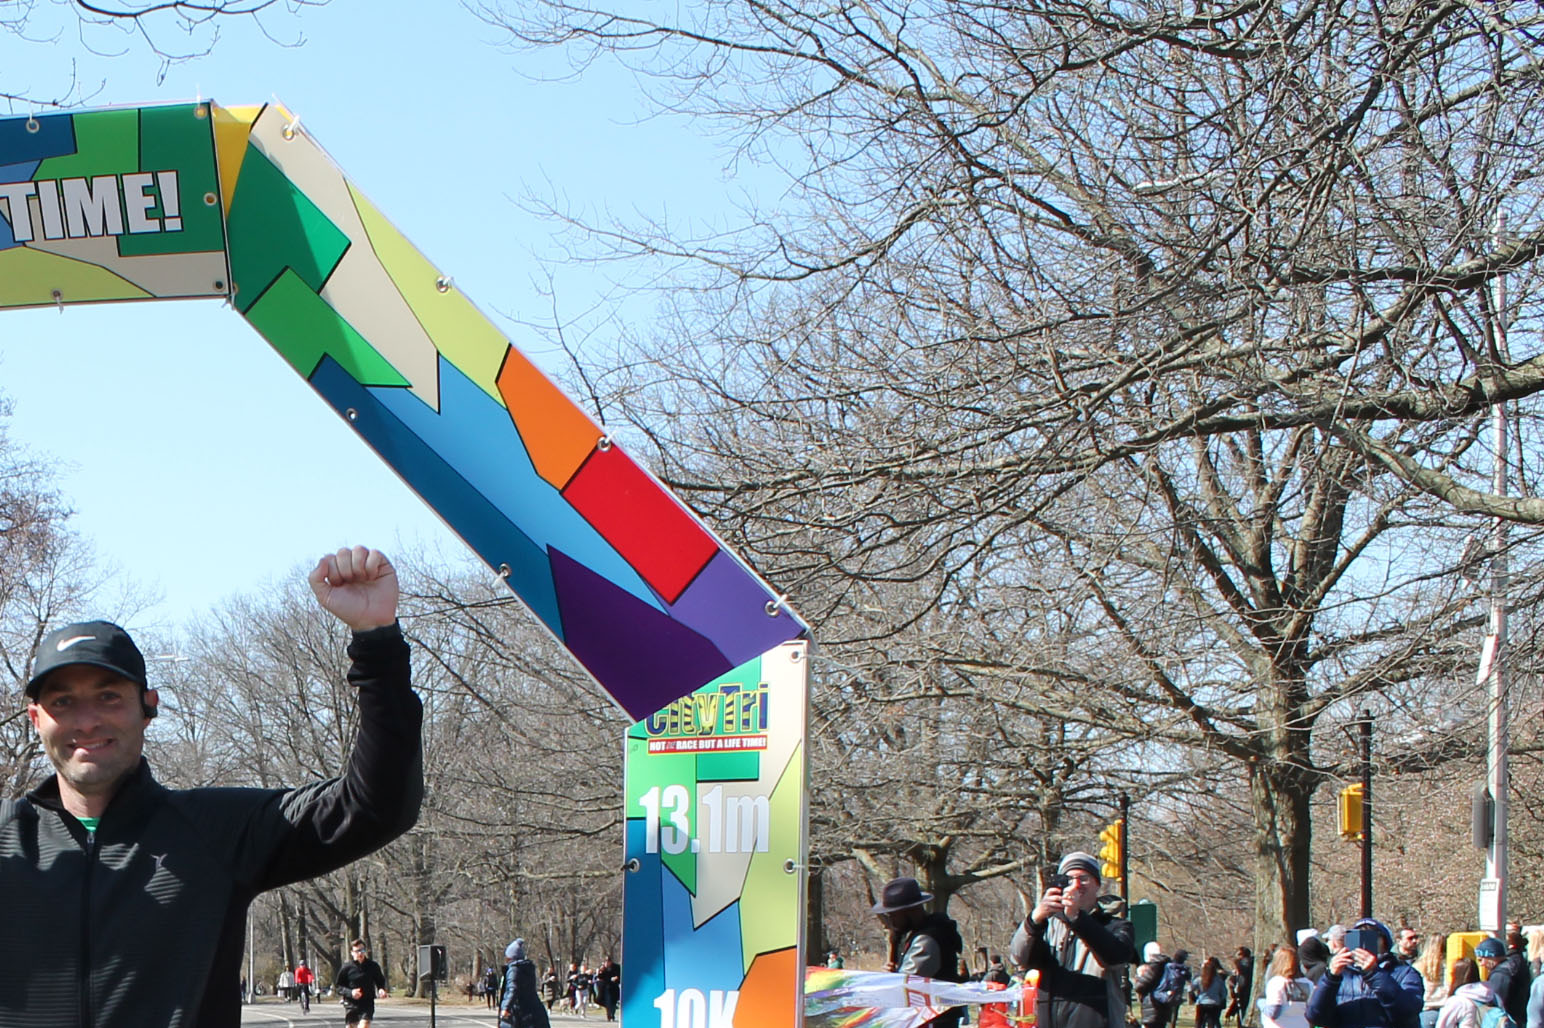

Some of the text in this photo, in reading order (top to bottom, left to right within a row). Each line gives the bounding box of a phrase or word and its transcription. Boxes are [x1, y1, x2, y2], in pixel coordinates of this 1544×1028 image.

[649, 741, 666, 751] NOT
[676, 740, 698, 750] RACE
[699, 739, 716, 749] BUT
[717, 738, 724, 748] A
[724, 738, 741, 748] LIFE
[638, 783, 771, 855] 13.1m
